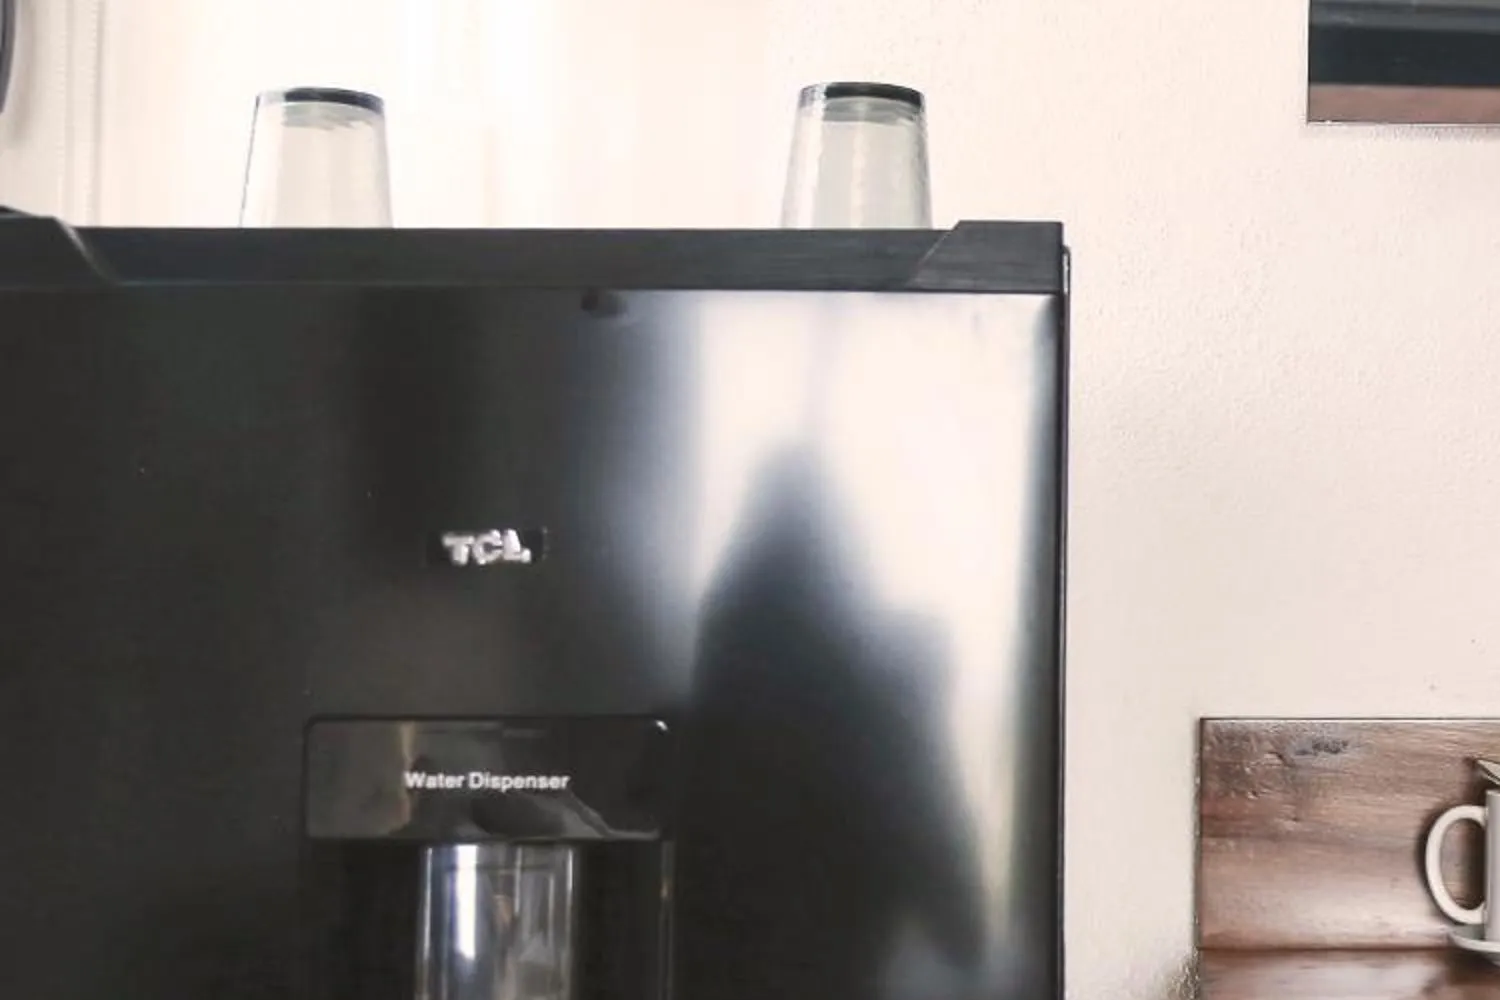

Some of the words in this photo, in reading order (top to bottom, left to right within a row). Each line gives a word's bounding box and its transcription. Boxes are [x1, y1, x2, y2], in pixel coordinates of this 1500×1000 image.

[442, 529, 531, 565] TCL
[404, 771, 466, 789] Water
[468, 772, 570, 792] Dispenser
